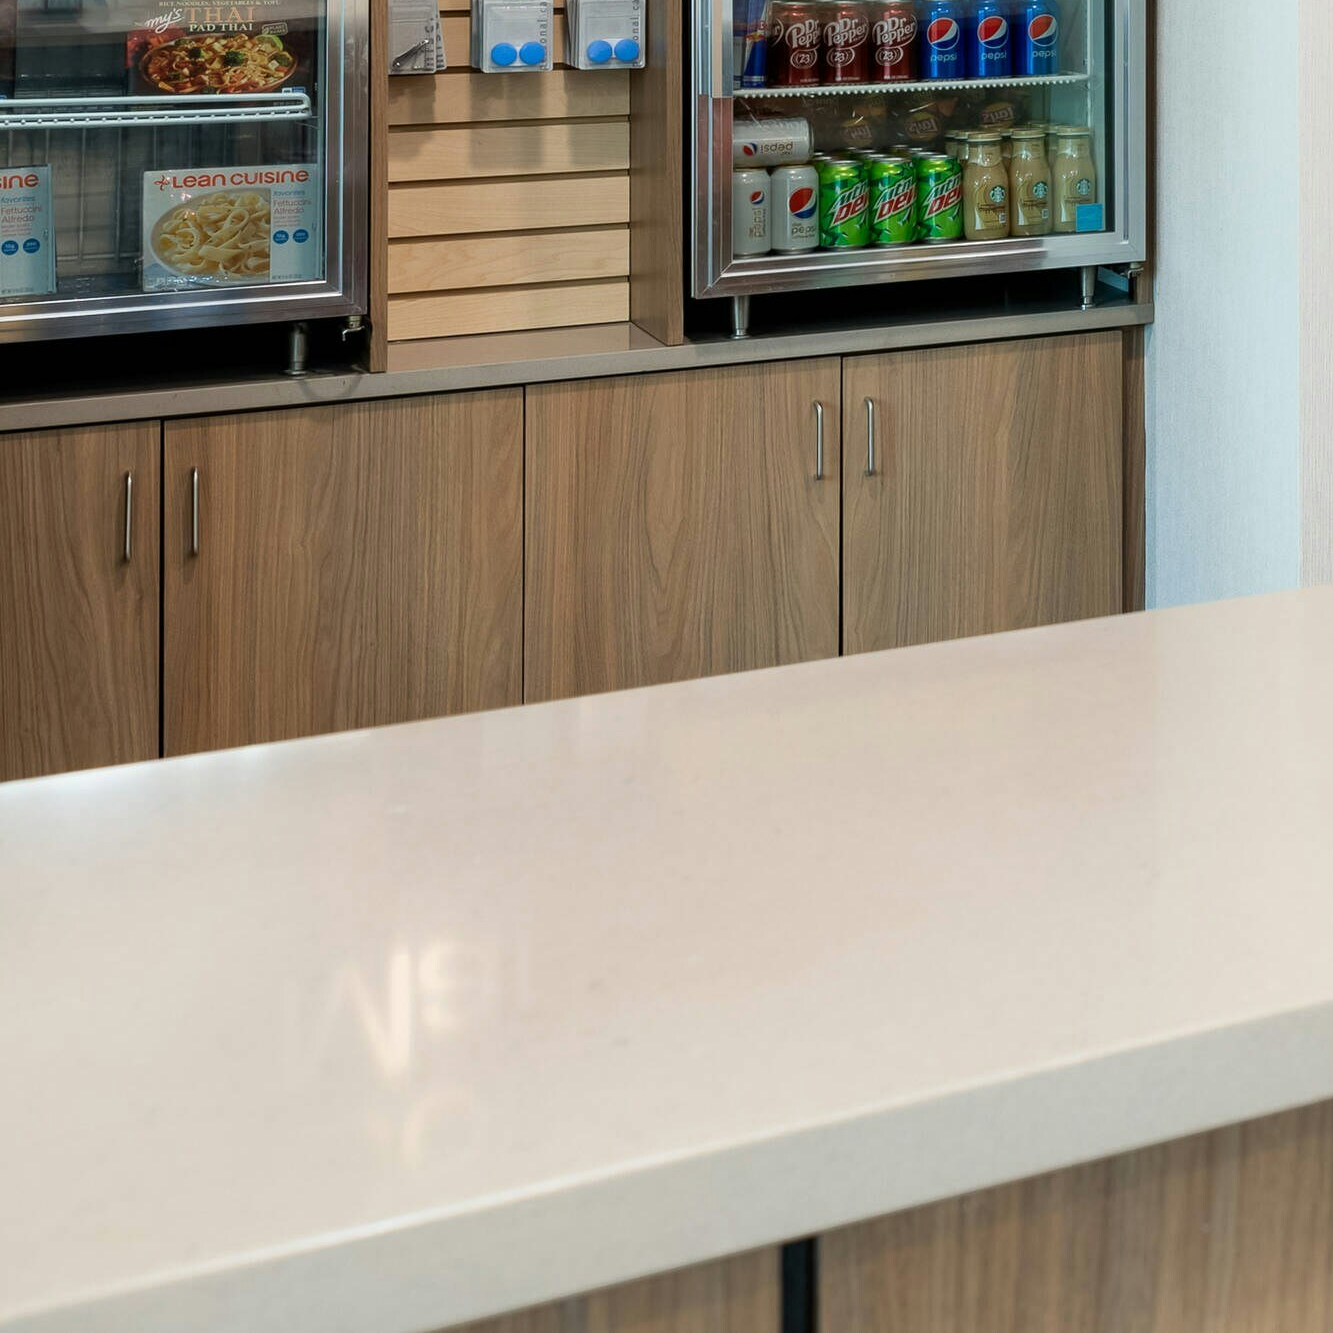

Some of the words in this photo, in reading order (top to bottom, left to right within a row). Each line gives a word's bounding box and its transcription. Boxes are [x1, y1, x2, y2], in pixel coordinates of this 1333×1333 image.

[186, 6, 256, 23] THAI
[189, 24, 216, 32] PAD
[221, 23, 253, 32] THAI
[805, 19, 820, 33] Dr
[839, 17, 858, 32] Dr
[887, 17, 907, 32] Dr
[828, 22, 867, 46] Pepper
[876, 21, 916, 46] Pepper
[799, 54, 810, 64] 23
[834, 51, 845, 62] 23
[882, 51, 894, 61] 23
[930, 52, 958, 63] pepsi
[981, 50, 1007, 61] pepsi
[1032, 49, 1057, 59] pepsi
[760, 141, 793, 154] pepsi
[172, 173, 227, 189] Lean
[1, 215, 35, 223] Alfredo
